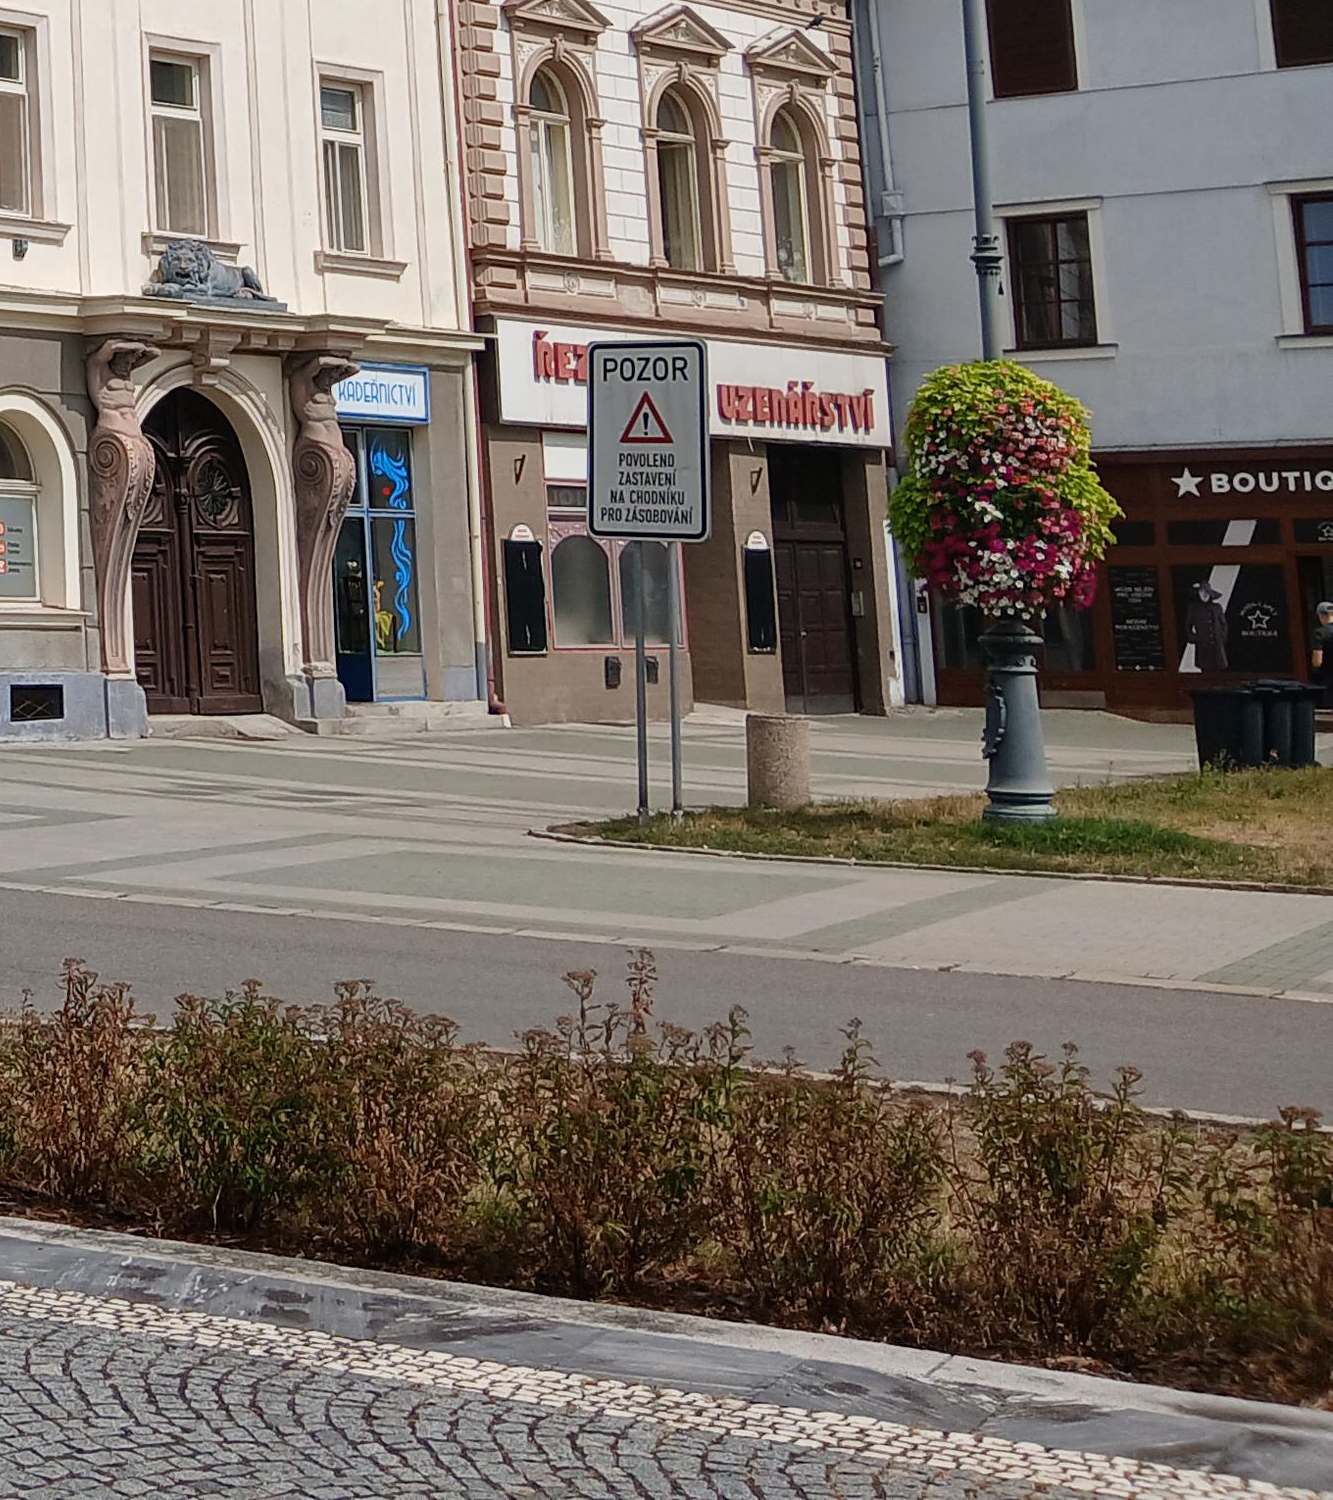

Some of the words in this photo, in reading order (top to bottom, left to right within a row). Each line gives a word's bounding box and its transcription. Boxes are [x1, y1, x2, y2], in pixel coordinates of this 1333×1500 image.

[602, 356, 689, 382] POZOR
[338, 379, 416, 406] KADEŘNICTVÍ
[717, 381, 875, 432] UZENÁŘSTVÍ
[619, 452, 675, 468] POVOLENO
[618, 469, 677, 486] ZASTAVENÍ
[610, 490, 625, 504] NA
[629, 486, 685, 505] CHODNÍKU
[601, 507, 622, 521] PRO
[625, 506, 694, 525] ZÁSOBOVÁNÍ
